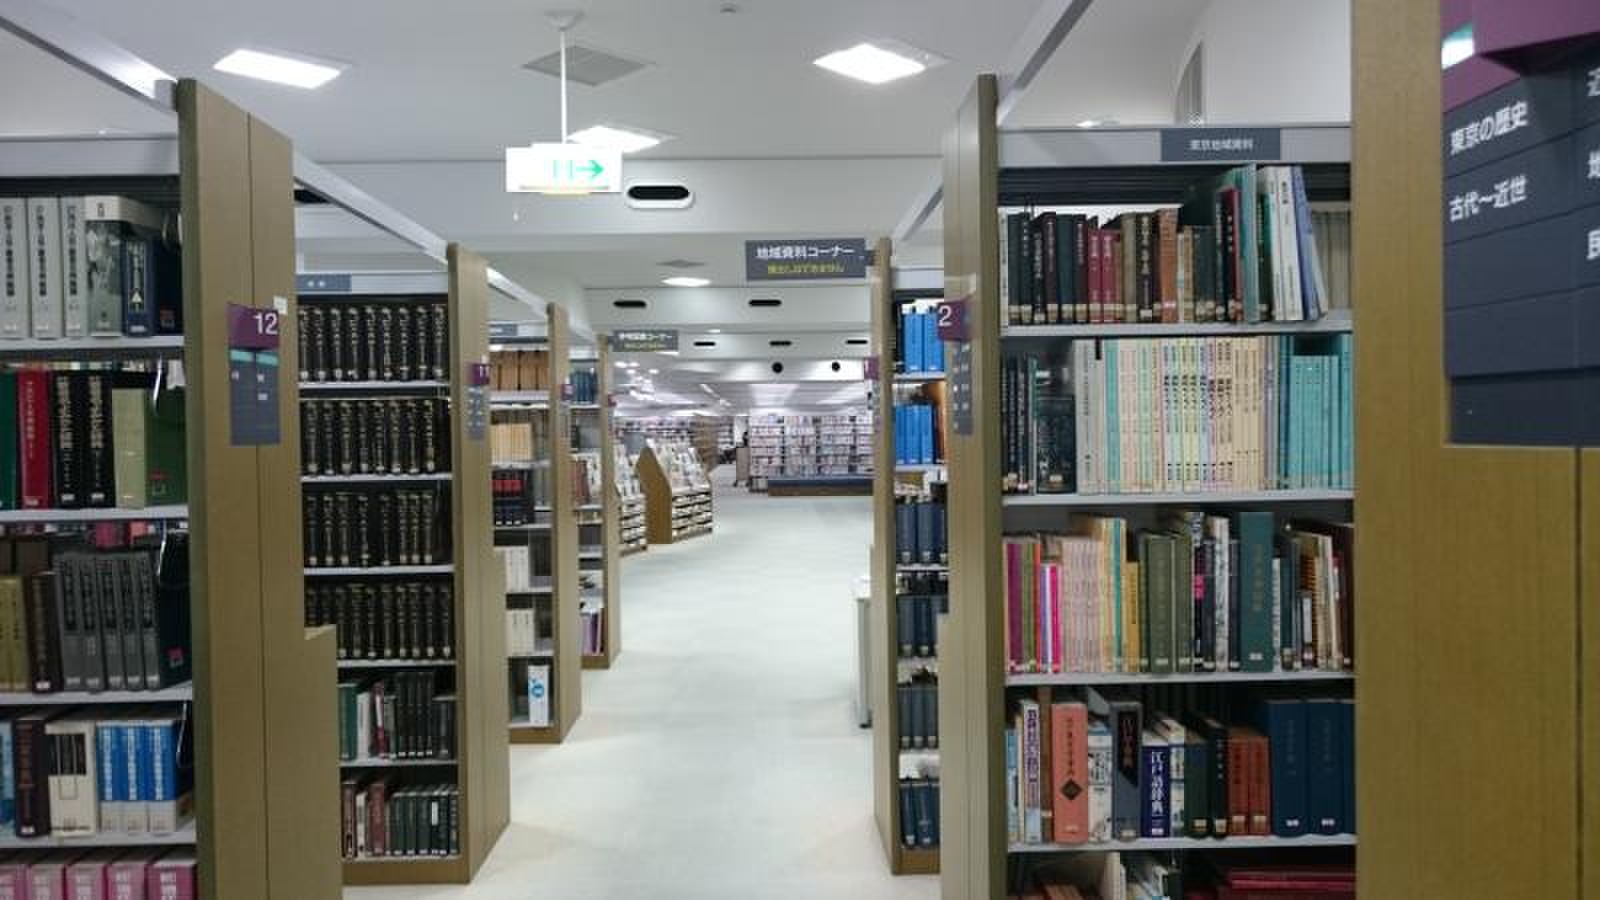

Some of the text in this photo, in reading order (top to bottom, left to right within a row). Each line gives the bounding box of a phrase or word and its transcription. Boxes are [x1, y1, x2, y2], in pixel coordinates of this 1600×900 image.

[1450, 102, 1528, 154] 東京の歴史
[755, 244, 856, 260] 地域資料コーナー
[253, 312, 278, 335] 12
[938, 304, 953, 326] 2
